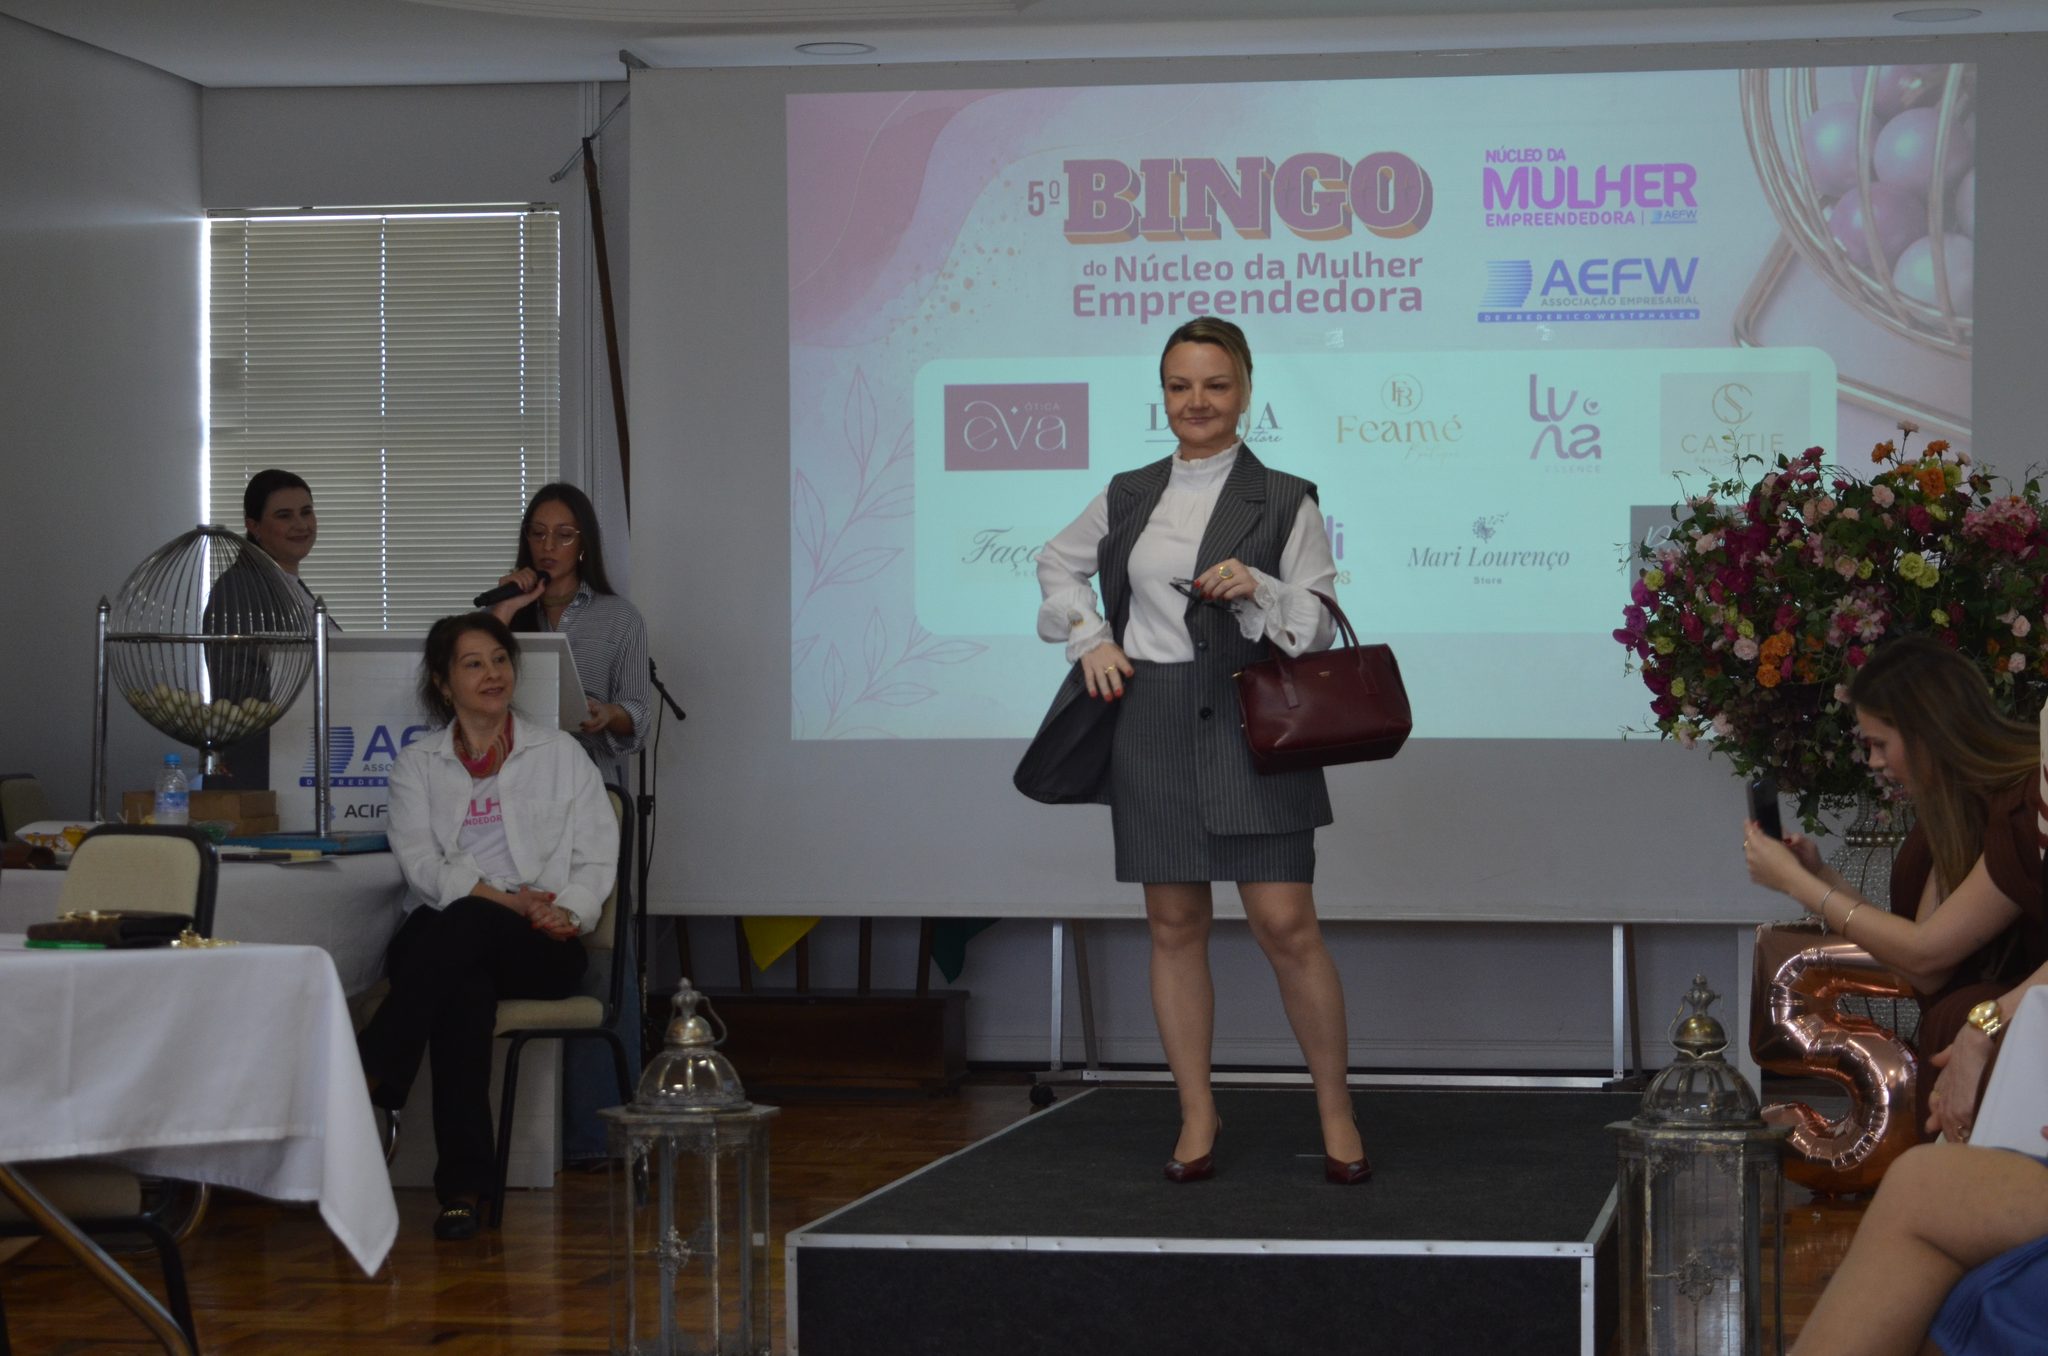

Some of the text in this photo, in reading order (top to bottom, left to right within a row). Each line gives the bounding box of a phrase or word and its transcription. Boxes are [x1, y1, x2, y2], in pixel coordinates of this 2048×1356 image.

[1485, 146, 1567, 164] NÚCLEO DA
[1063, 151, 1434, 245] BINGO
[1482, 163, 1698, 211] MULHER
[1485, 209, 1698, 228] EMPREENDEDORA AEFW
[1083, 251, 1423, 282] do Núcleo da Mulher
[1539, 257, 1700, 297] AEFW
[1073, 279, 1422, 324] Empreendedora
[1541, 296, 1699, 307] ASSOCIAÇÃO EMPRESARIAL
[1484, 311, 1697, 322] DE FREDERICO WESTPHALEN
[1337, 414, 1463, 443] Feamé
[1408, 546, 1570, 571] Mari Lourenço
[1473, 576, 1502, 585] Store
[344, 804, 388, 819] ACIF
